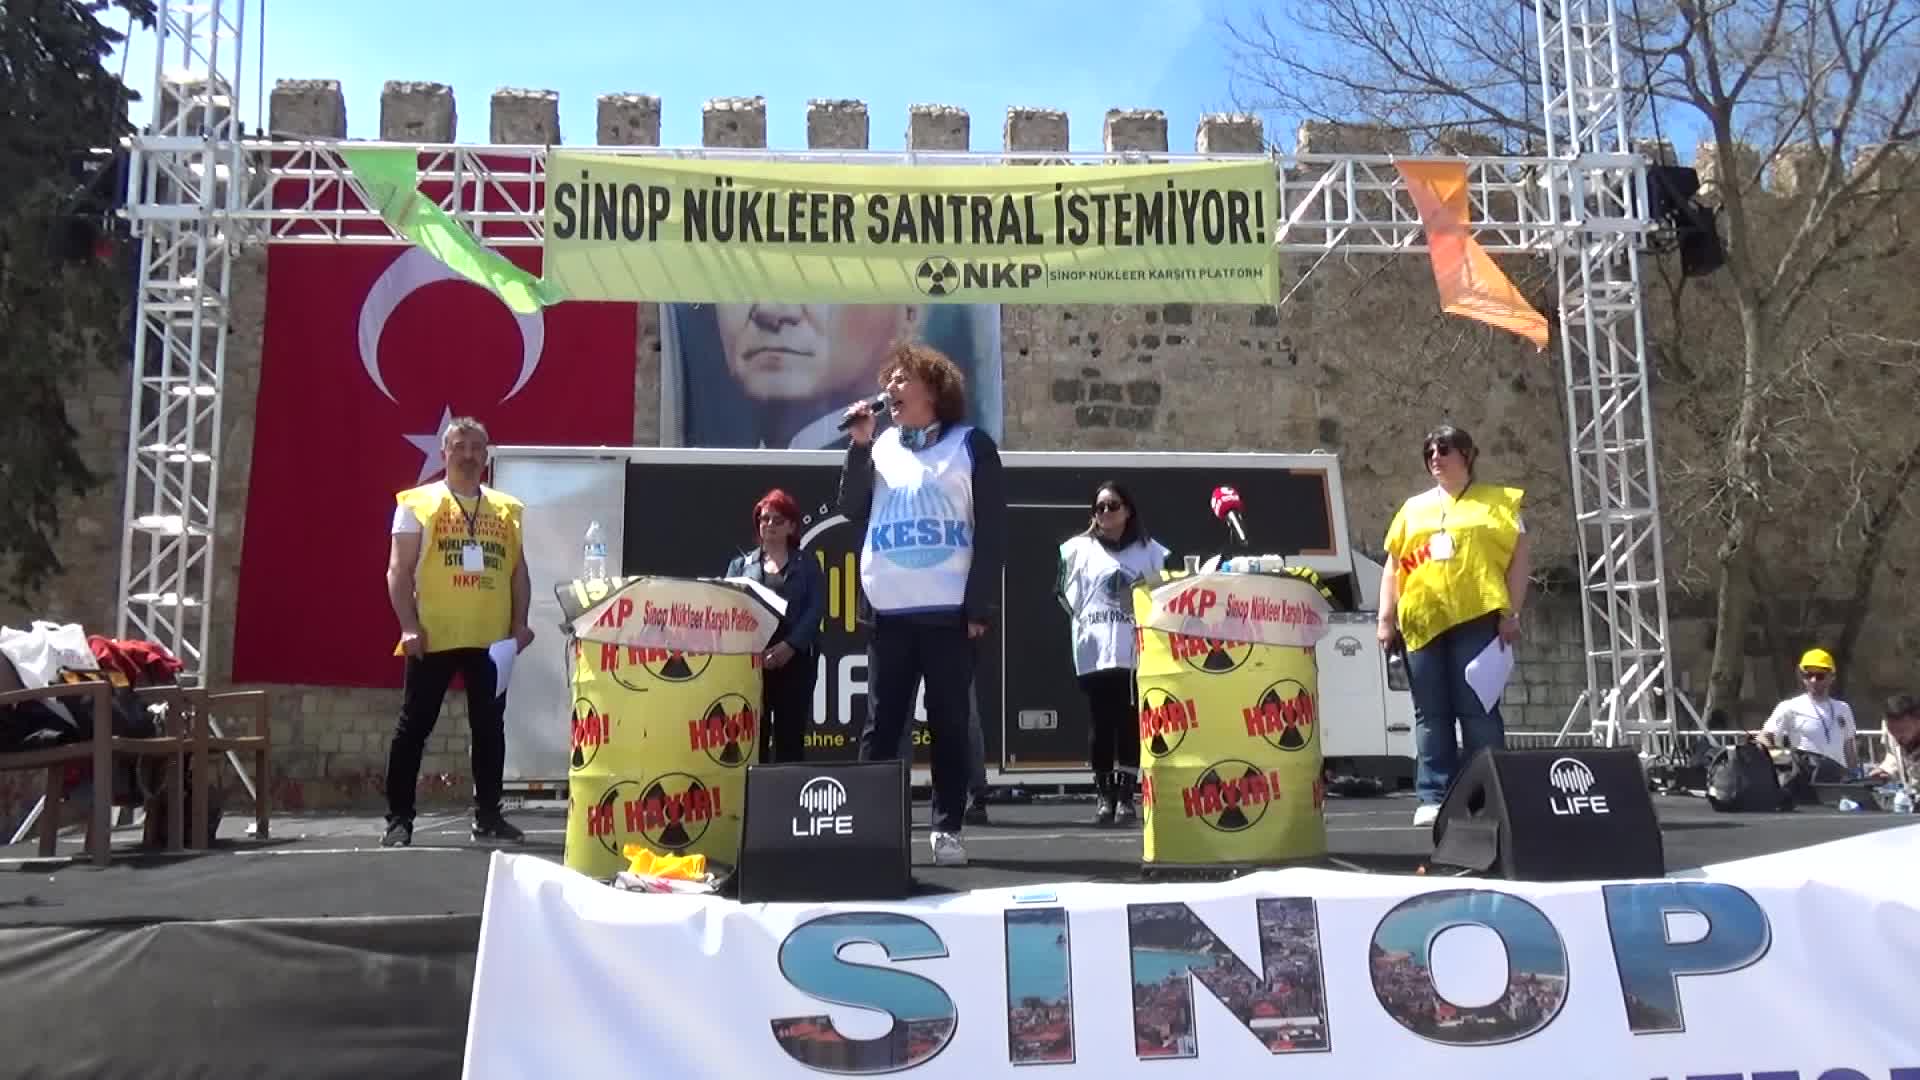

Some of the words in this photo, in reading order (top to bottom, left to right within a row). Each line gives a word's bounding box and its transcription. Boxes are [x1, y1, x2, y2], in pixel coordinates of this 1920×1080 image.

[553, 170, 671, 242] SİNOP
[683, 177, 856, 243] NÜKLEER
[867, 193, 1043, 245] SANTRAL
[1055, 180, 1266, 246] İSTEMİYOR!
[963, 263, 1042, 289] NKP
[1050, 268, 1086, 281] SİNOP
[1089, 266, 1145, 281] NÜKLEER
[1200, 266, 1264, 280] PLATFORM
[872, 519, 968, 551] KESK
[803, 731, 845, 747] ahne
[1182, 769, 1281, 818] HAYIR!
[1550, 795, 1610, 816] LIFE
[624, 786, 721, 833] HAYIR!
[792, 816, 853, 836] LIFE
